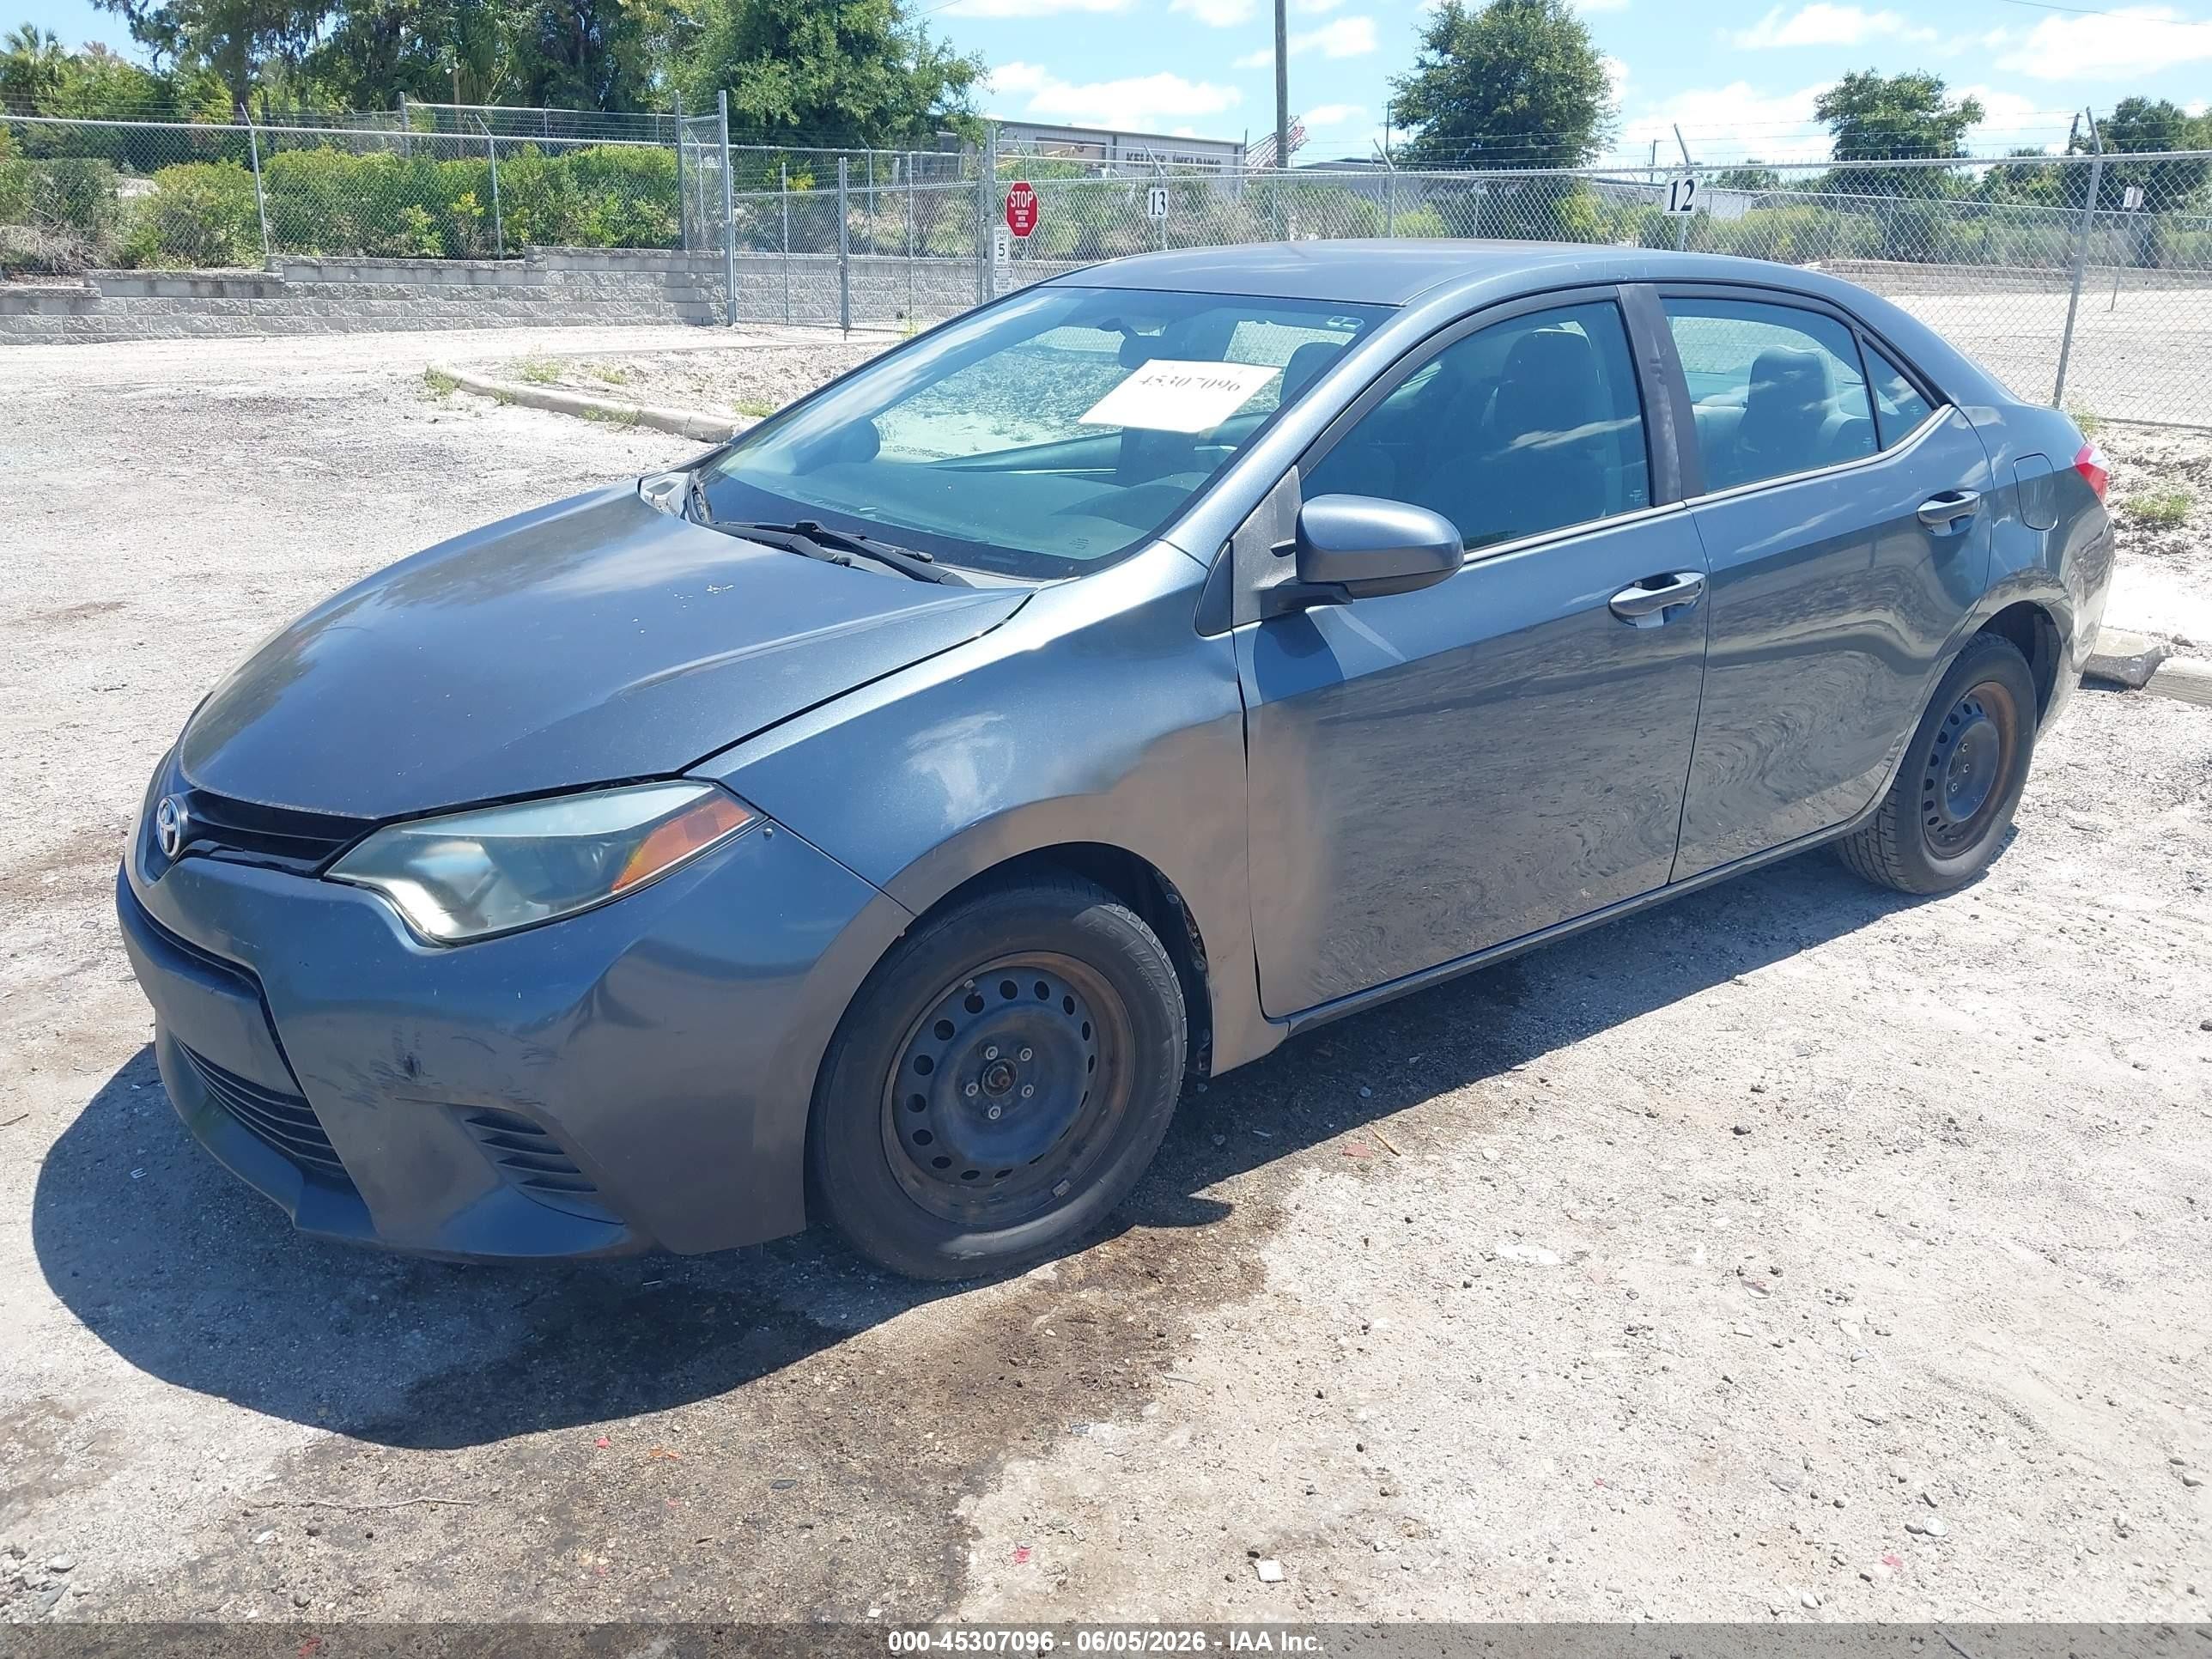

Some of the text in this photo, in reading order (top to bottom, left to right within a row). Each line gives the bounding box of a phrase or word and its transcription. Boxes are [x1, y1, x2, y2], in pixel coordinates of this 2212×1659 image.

[1127, 153, 1167, 169] KELLES
[1011, 191, 1033, 208] STOP
[1151, 191, 1166, 216] 13
[1668, 179, 1694, 211] 12
[999, 243, 1006, 257] 5
